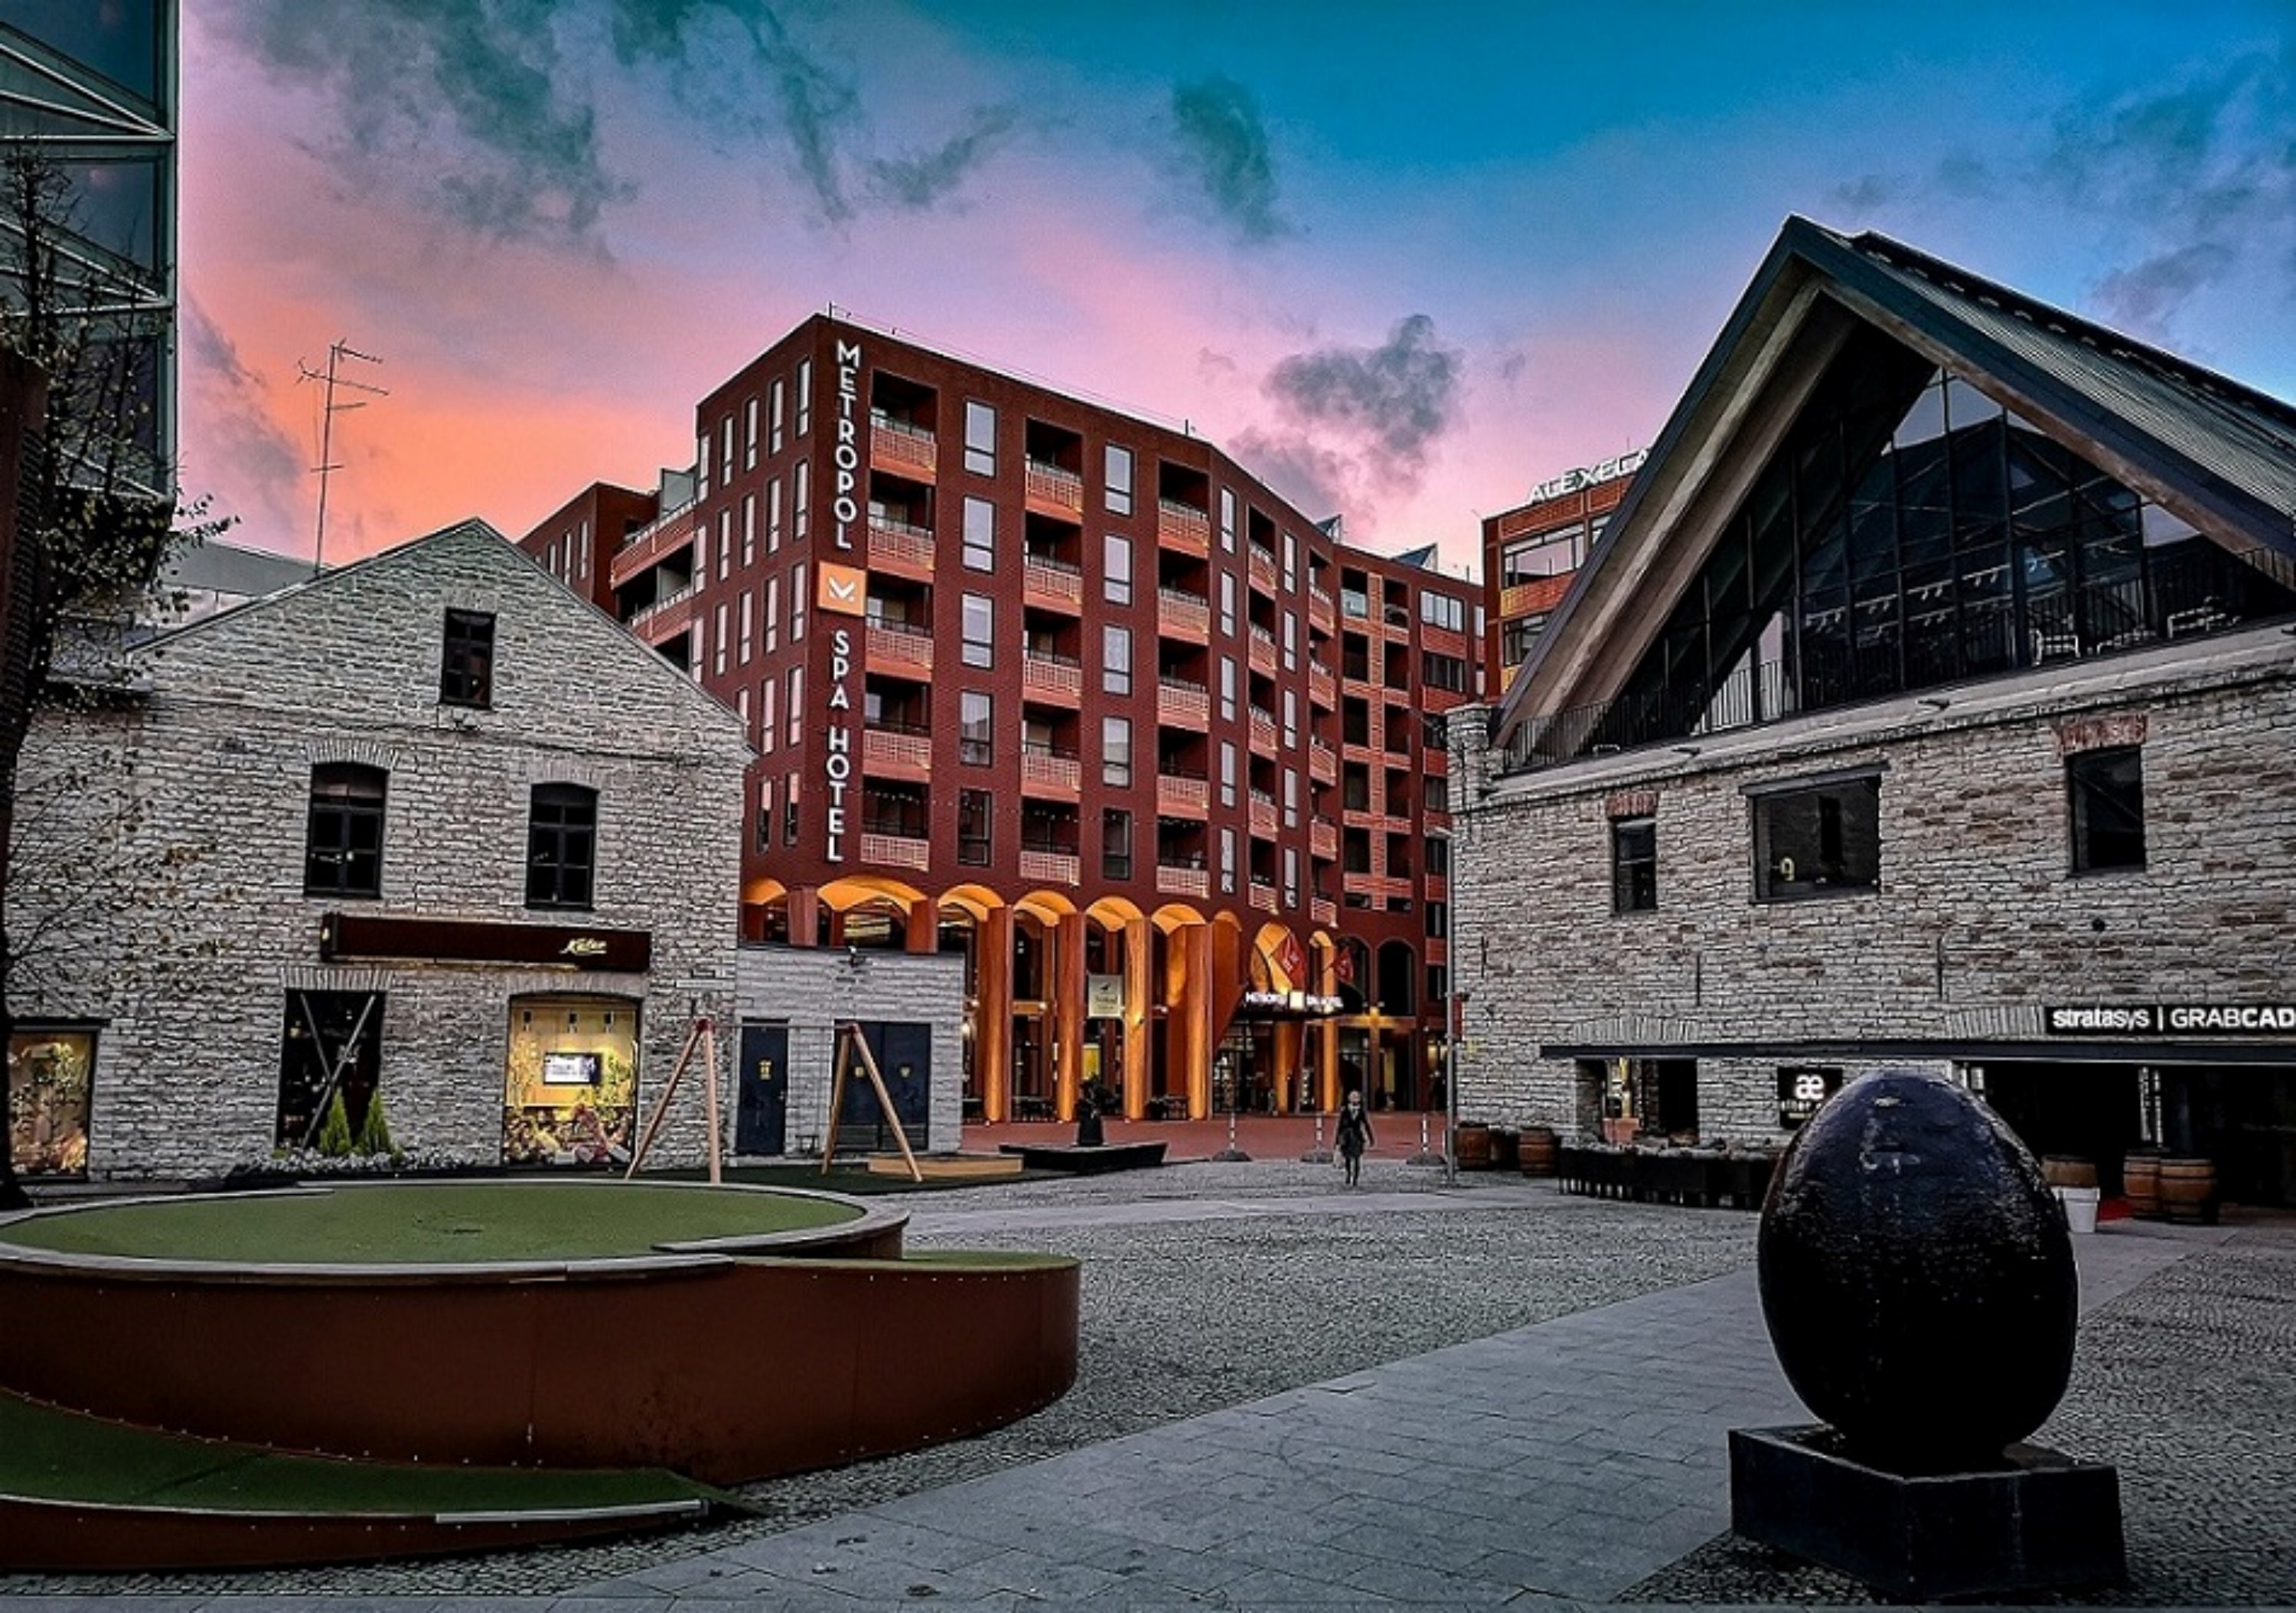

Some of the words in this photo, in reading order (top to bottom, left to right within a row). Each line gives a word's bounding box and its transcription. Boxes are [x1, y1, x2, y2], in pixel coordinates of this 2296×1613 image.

[833, 339, 859, 549] METROPOL
[1528, 449, 1648, 502] ALEXELA
[830, 629, 850, 710] SPA
[827, 725, 850, 862] HOTEL
[2053, 1007, 2151, 1031] stratasys
[2170, 1007, 2295, 1028] GRABCAD
